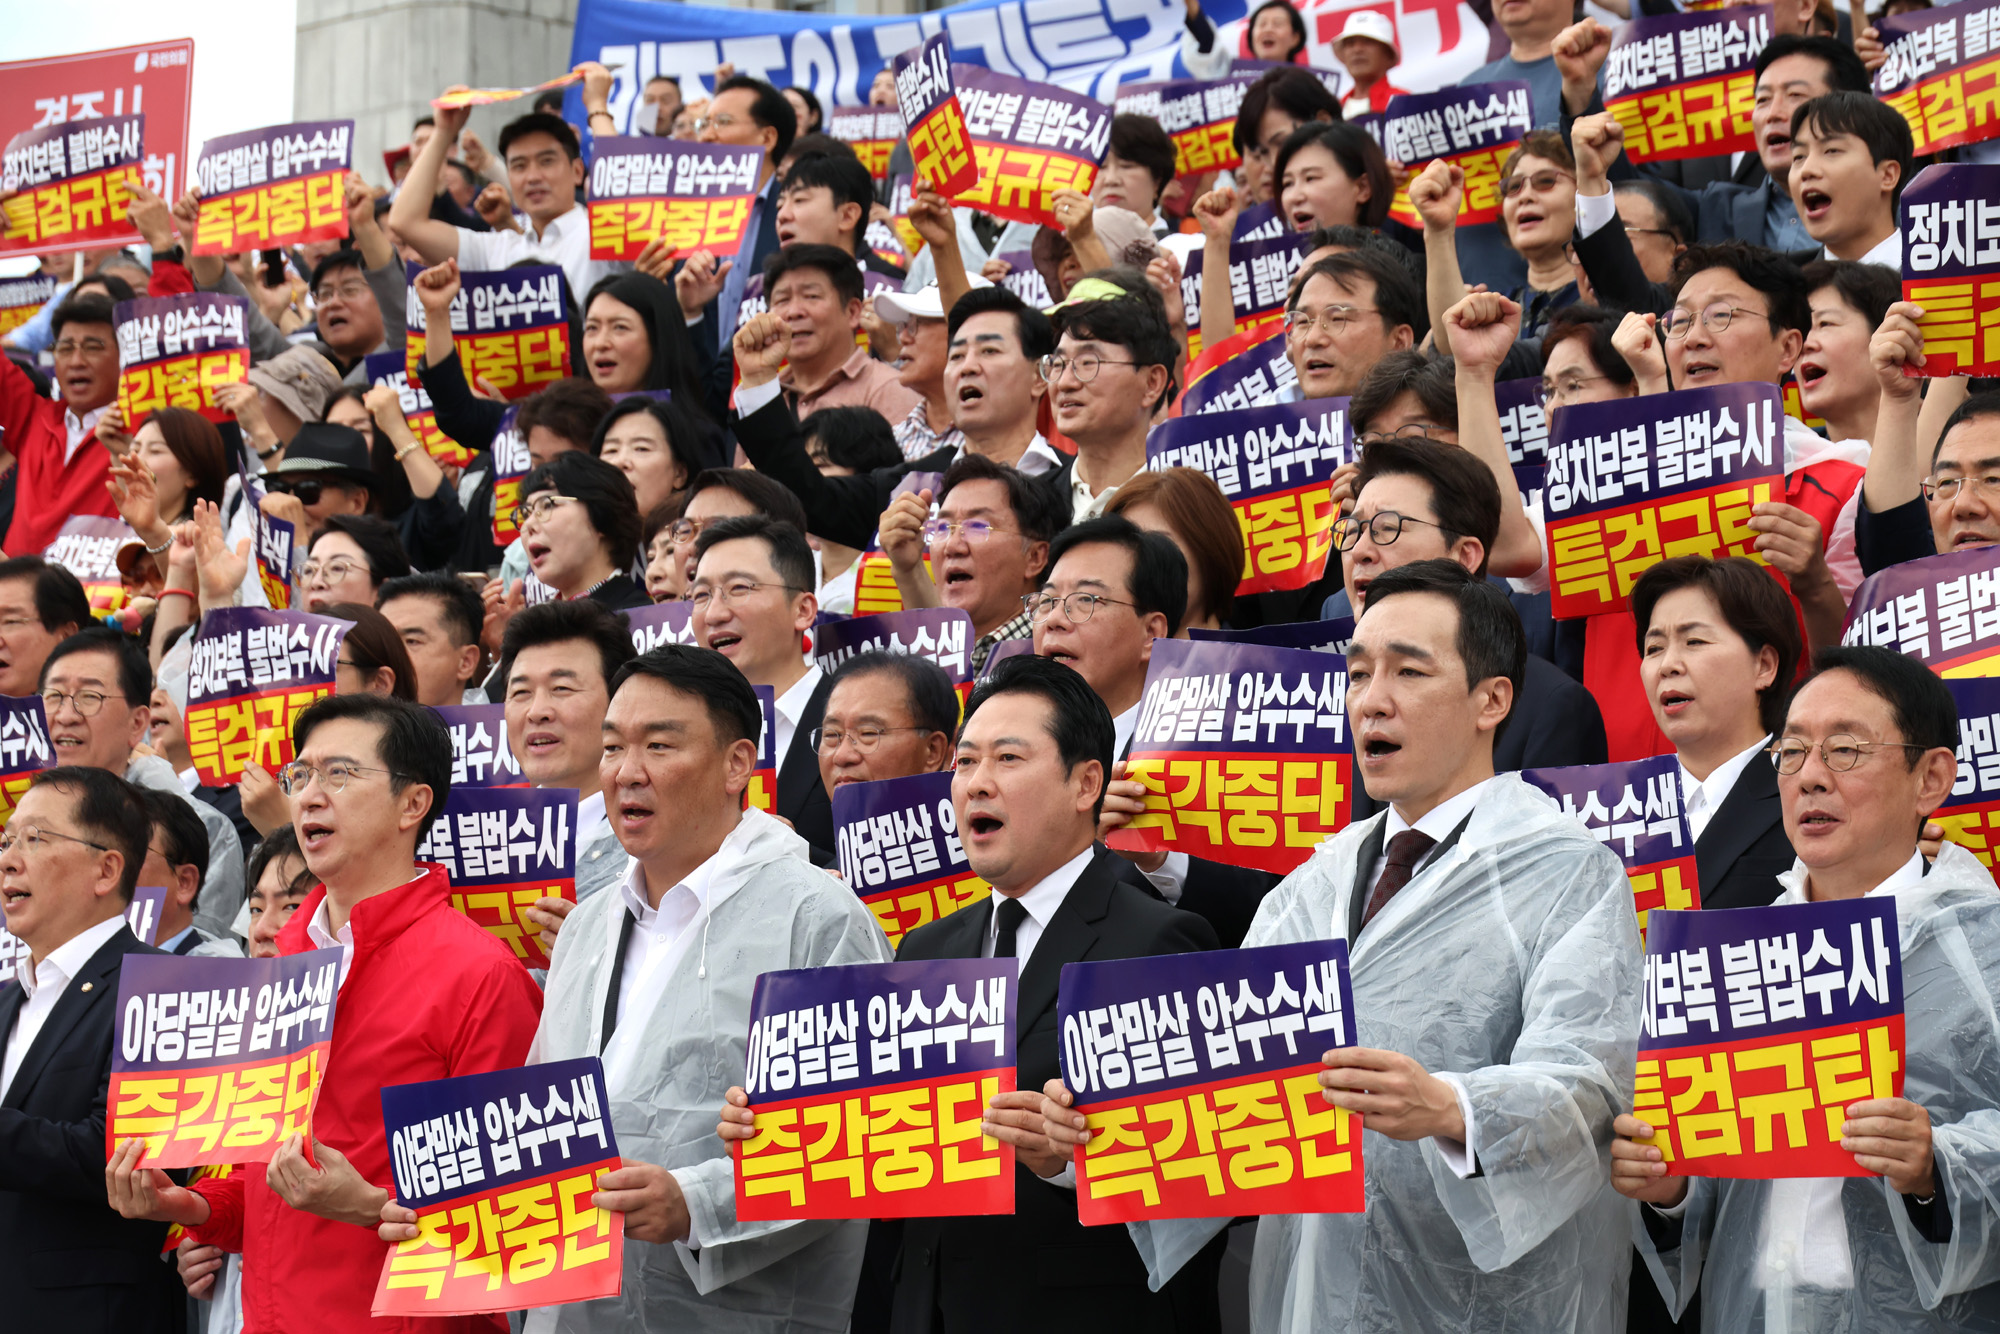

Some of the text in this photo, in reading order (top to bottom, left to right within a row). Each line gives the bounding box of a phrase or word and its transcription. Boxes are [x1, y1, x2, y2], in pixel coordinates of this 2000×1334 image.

[1605, 13, 1770, 97] 정치보복 불법수사
[1878, 17, 1959, 92] 정치보복
[4, 119, 140, 192] 정치보복 불법수사
[199, 140, 268, 196] 야당말살
[271, 126, 349, 179] 압수수색
[908, 103, 970, 192] 규탄
[955, 86, 1024, 140] 치보복
[1014, 96, 1112, 160] 불법수사
[1384, 108, 1450, 164] 야당말살
[1443, 88, 1532, 150] 압수수색
[3, 166, 143, 243] 특검규탄
[197, 171, 344, 249] 즉각중단
[592, 153, 759, 198] 야당말살 압수수색
[953, 145, 1094, 212] 검규탄
[591, 198, 749, 255] 즉각중단
[163, 304, 245, 355] 압수수색
[472, 273, 562, 330] 압수수색
[118, 352, 246, 429] 각중단
[1243, 409, 1345, 490] 압수수색
[1498, 403, 1550, 465] 보복
[1546, 399, 1777, 513] 정치보복 불법수사
[1232, 486, 1345, 581] 중단
[188, 623, 342, 700] 정치보복 불법수사
[1135, 671, 1347, 744] 야당말살 압수수색
[457, 803, 570, 877] 불법수사
[1118, 759, 1345, 849] 즉각중단
[837, 802, 941, 889] 야당말살
[121, 961, 337, 1064] 야당말살 압수수색
[1639, 916, 1892, 1039] 치보복 불법수사
[745, 976, 1007, 1095] 야당말살 압수수색
[1063, 958, 1347, 1095] 야당말살 압수수색
[113, 1049, 320, 1160] 즉각중단
[392, 1072, 609, 1201] 야당말살 압수수색
[740, 1076, 1002, 1208] 즉각중단
[1084, 1071, 1353, 1208] 즉각중단
[385, 1166, 612, 1301] 즉각중단
